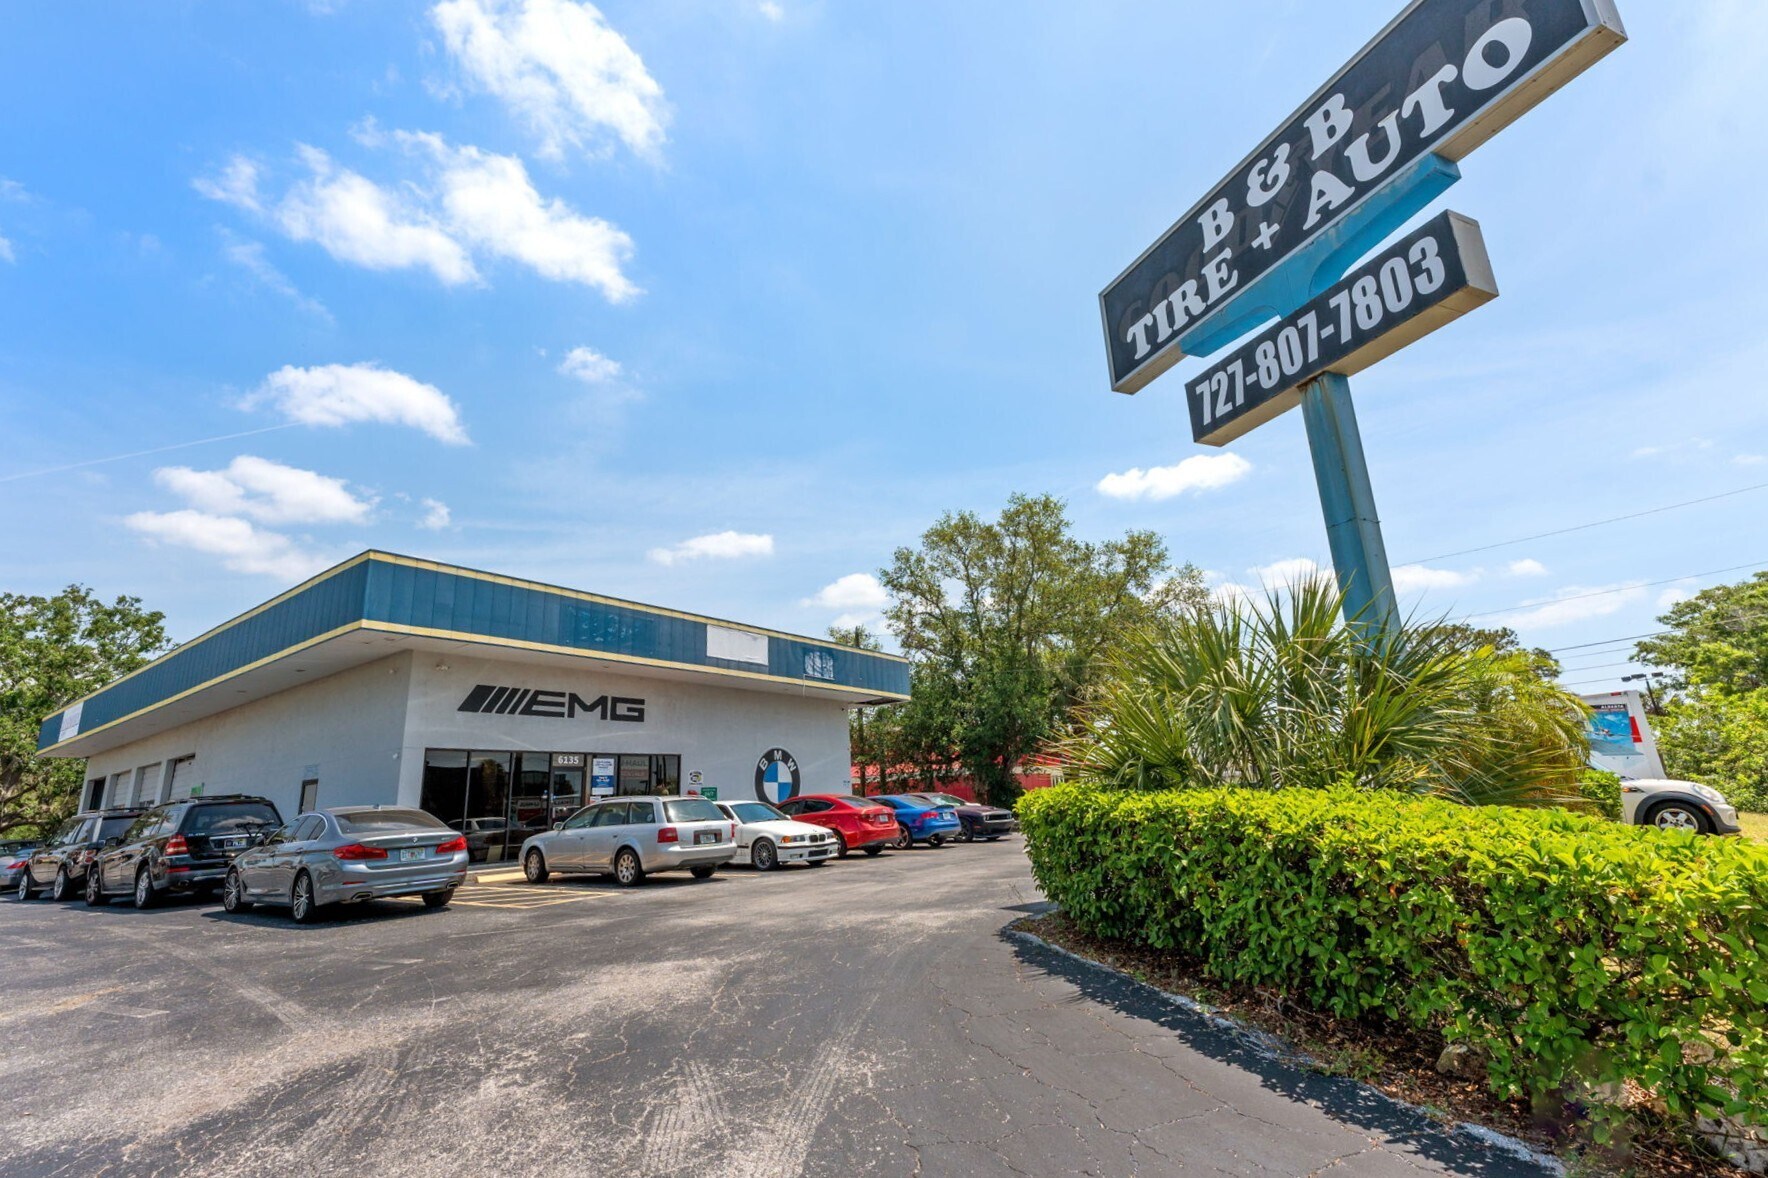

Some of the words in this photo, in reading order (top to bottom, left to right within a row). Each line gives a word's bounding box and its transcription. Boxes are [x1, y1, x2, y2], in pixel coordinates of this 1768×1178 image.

[1126, 246, 1239, 361] TIRE
[1251, 221, 1280, 250] +
[1303, 17, 1533, 231] AUTO
[1198, 198, 1235, 254] B
[1246, 142, 1290, 208] &
[1304, 93, 1354, 161] B
[1195, 235, 1446, 427] 727-807-7803
[557, 755, 580, 765] 6135
[759, 750, 797, 772] BMW
